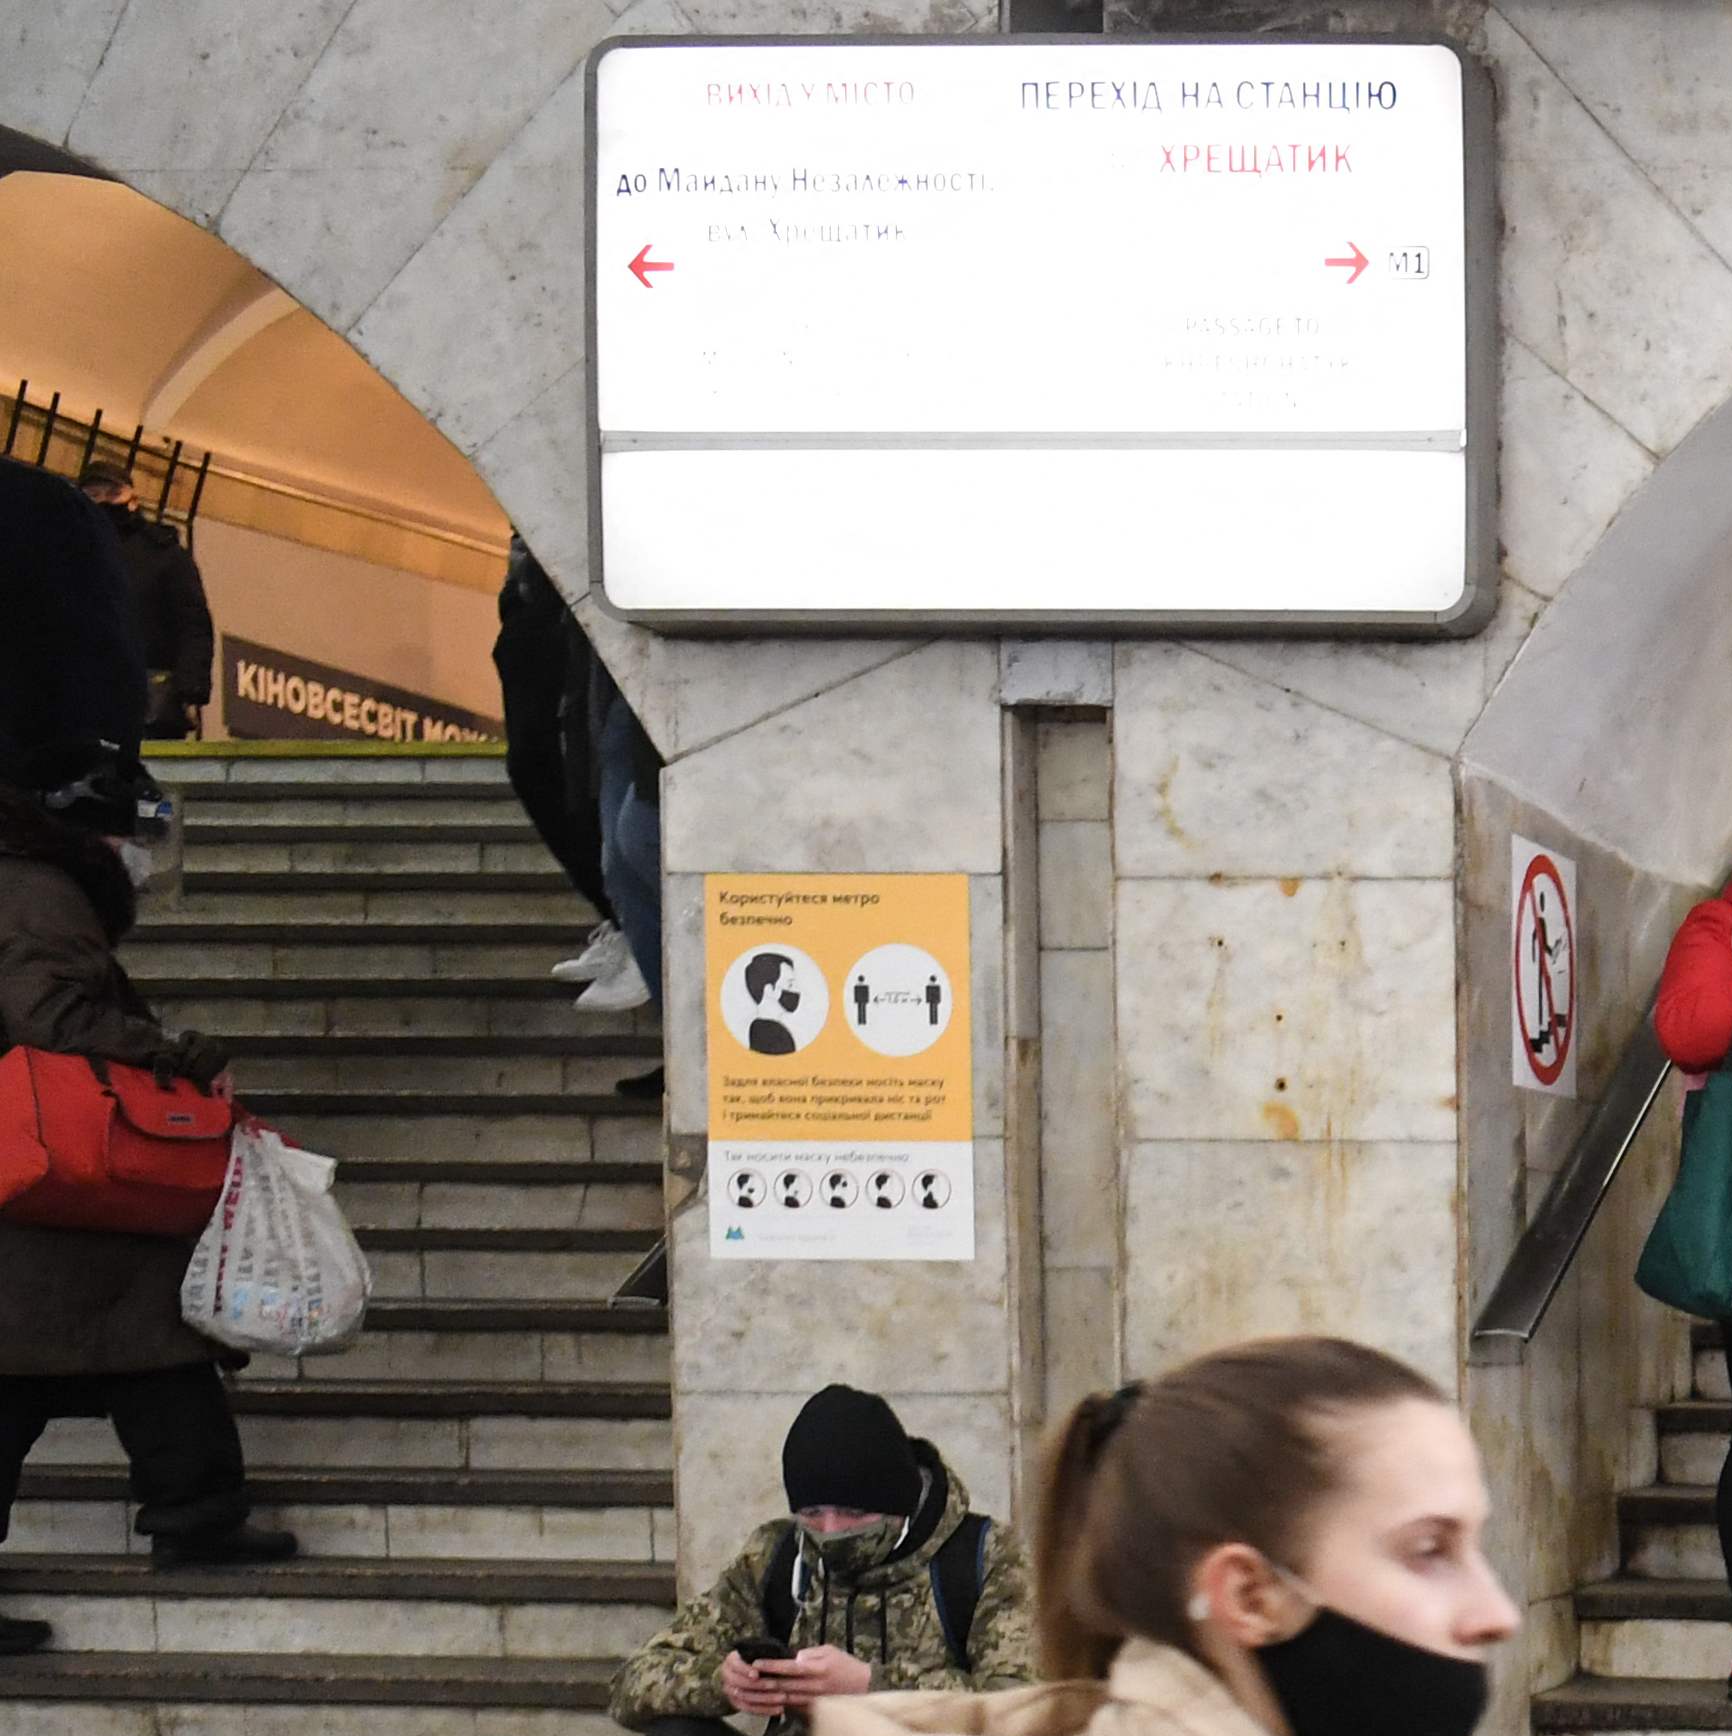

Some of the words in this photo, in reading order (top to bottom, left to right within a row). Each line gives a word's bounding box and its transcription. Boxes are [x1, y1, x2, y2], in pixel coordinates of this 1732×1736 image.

[1022, 80, 1163, 112] ПЕРЕХІД
[1180, 81, 1224, 108] НА
[1236, 80, 1398, 113] СТАНЦІЮ
[1160, 143, 1353, 178] ХРЕЩАТИК
[615, 173, 647, 198] до
[719, 889, 828, 910] Користуйтеся
[832, 893, 881, 909] метро
[719, 911, 793, 927] безпечно
